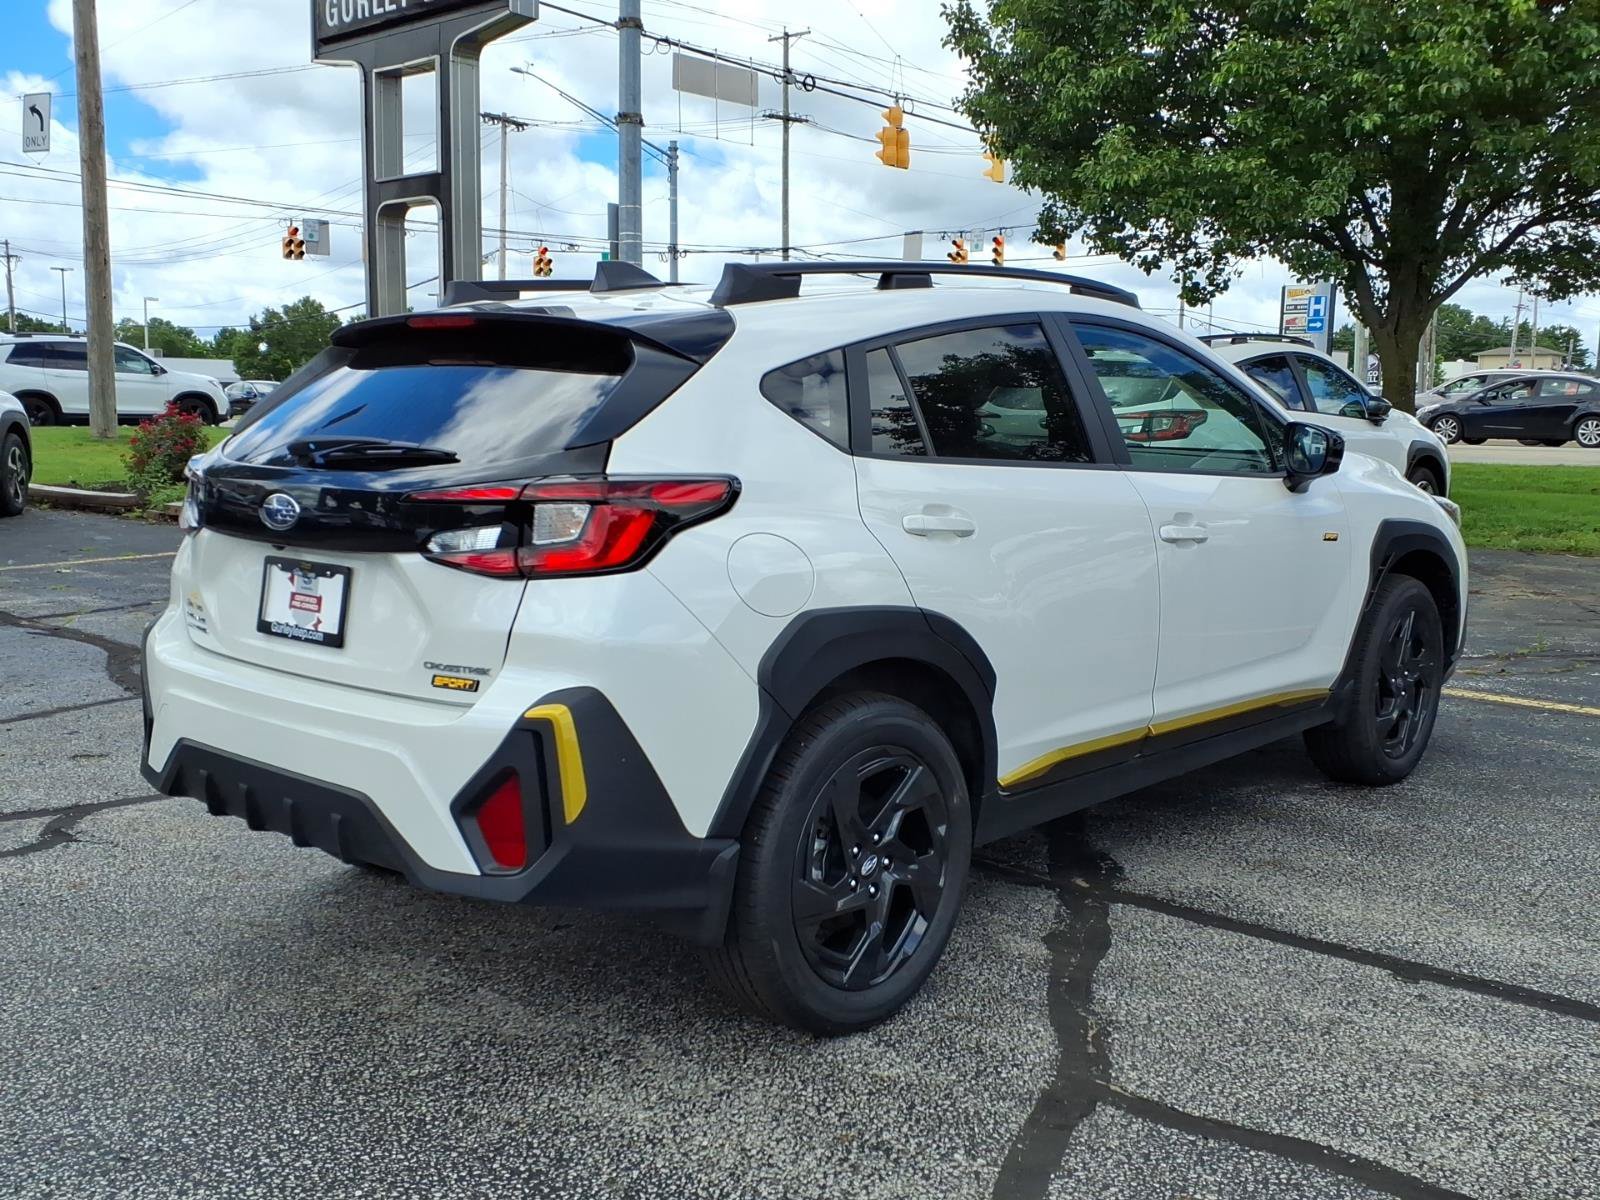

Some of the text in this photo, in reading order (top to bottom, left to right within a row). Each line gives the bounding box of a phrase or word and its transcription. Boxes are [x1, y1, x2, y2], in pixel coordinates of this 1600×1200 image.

[25, 135, 47, 147] ONLY
[1309, 297, 1326, 317] H
[424, 661, 492, 677] CROSSTREK
[433, 676, 474, 689] SPORT
